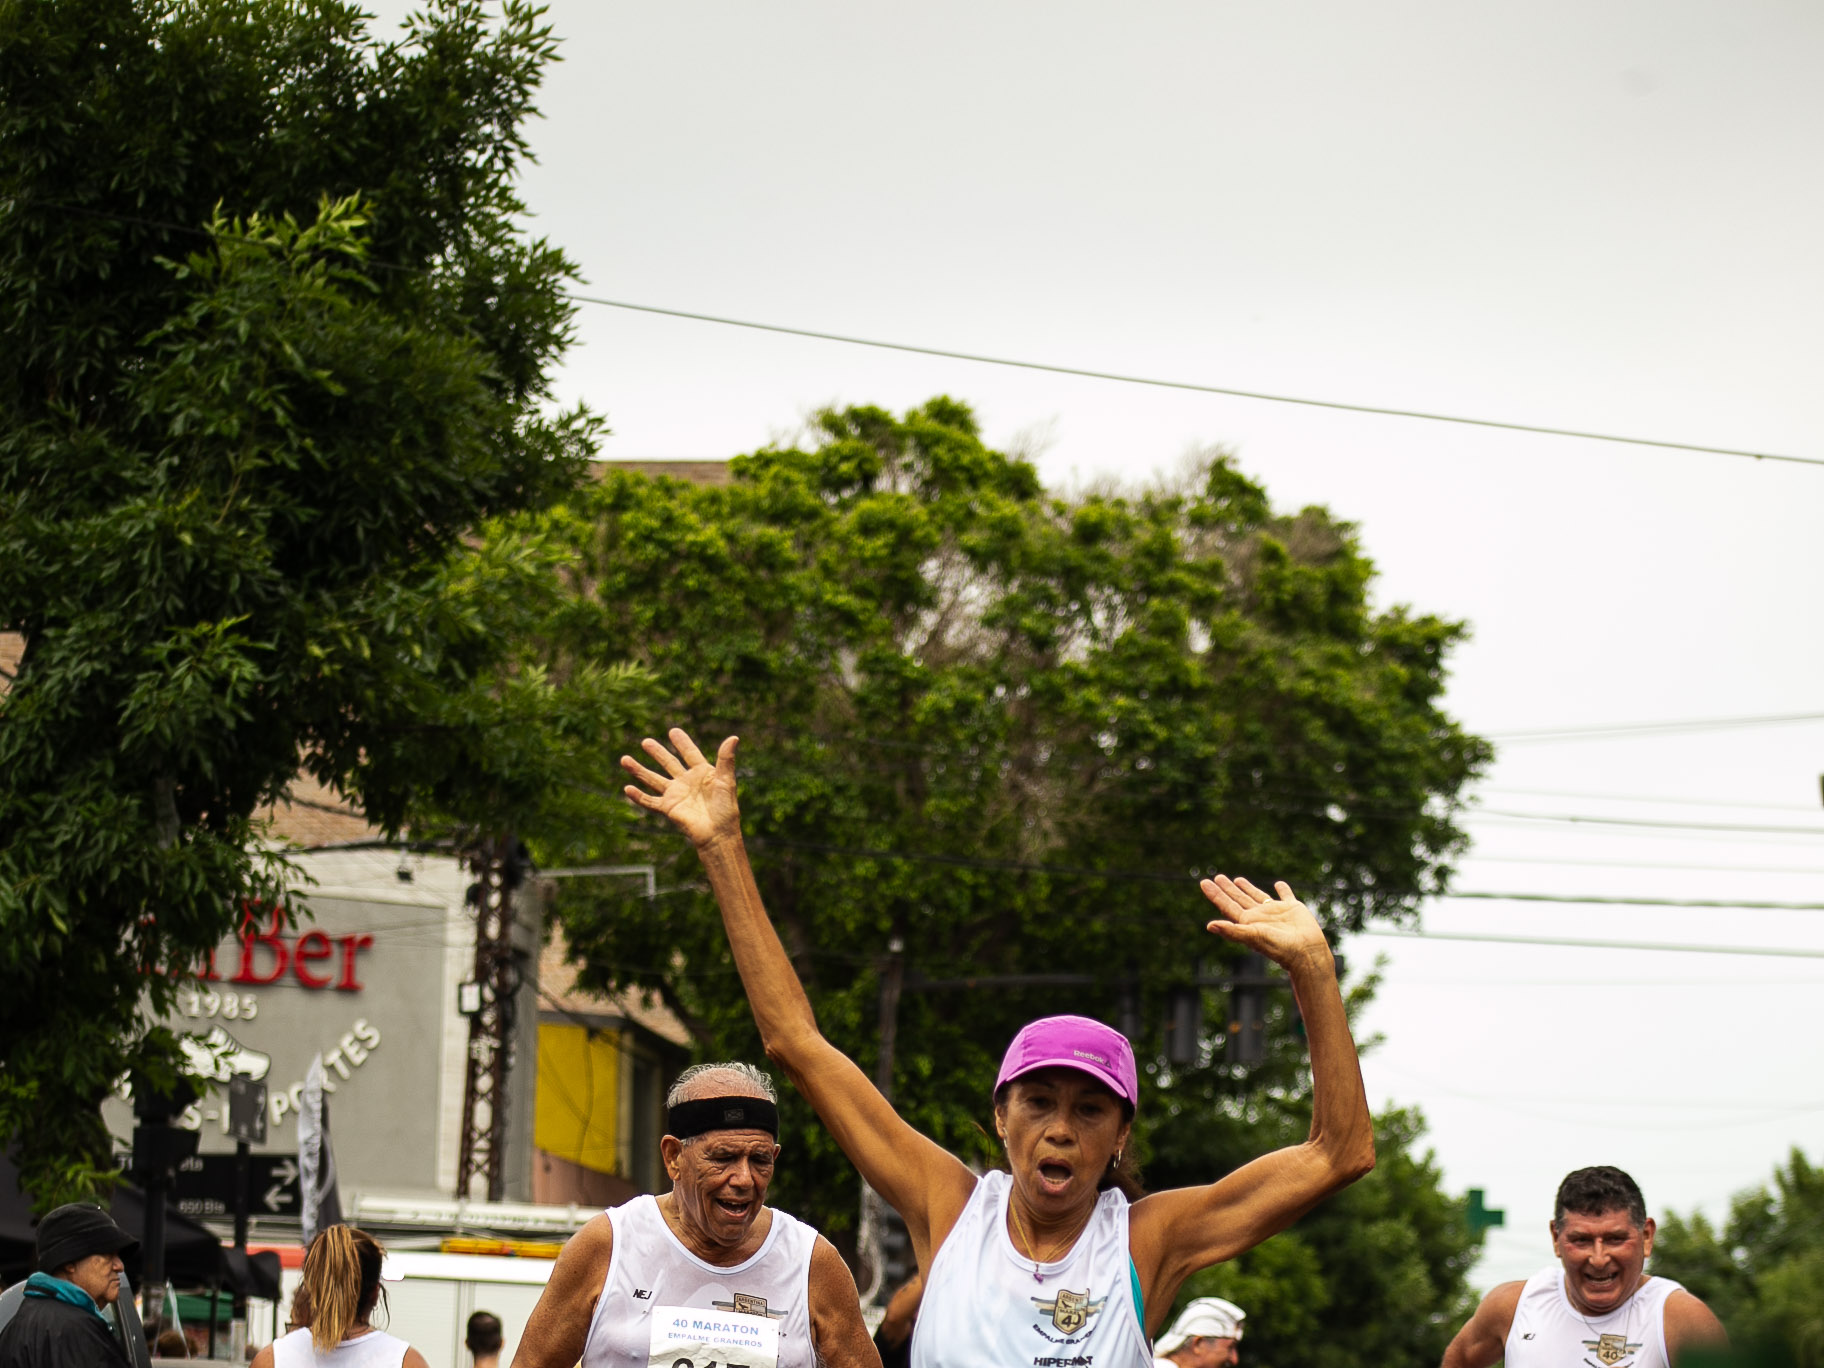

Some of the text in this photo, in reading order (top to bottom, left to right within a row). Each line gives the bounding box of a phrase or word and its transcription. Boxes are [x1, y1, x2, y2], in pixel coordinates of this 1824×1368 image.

[187, 991, 258, 1019] 1985
[1073, 1050, 1104, 1065] Reebok
[632, 1288, 653, 1300] NEJ
[672, 1318, 760, 1336] 40 MARATON
[667, 1332, 763, 1348] EMPALME GRANEROS
[1603, 1350, 1618, 1361] 40
